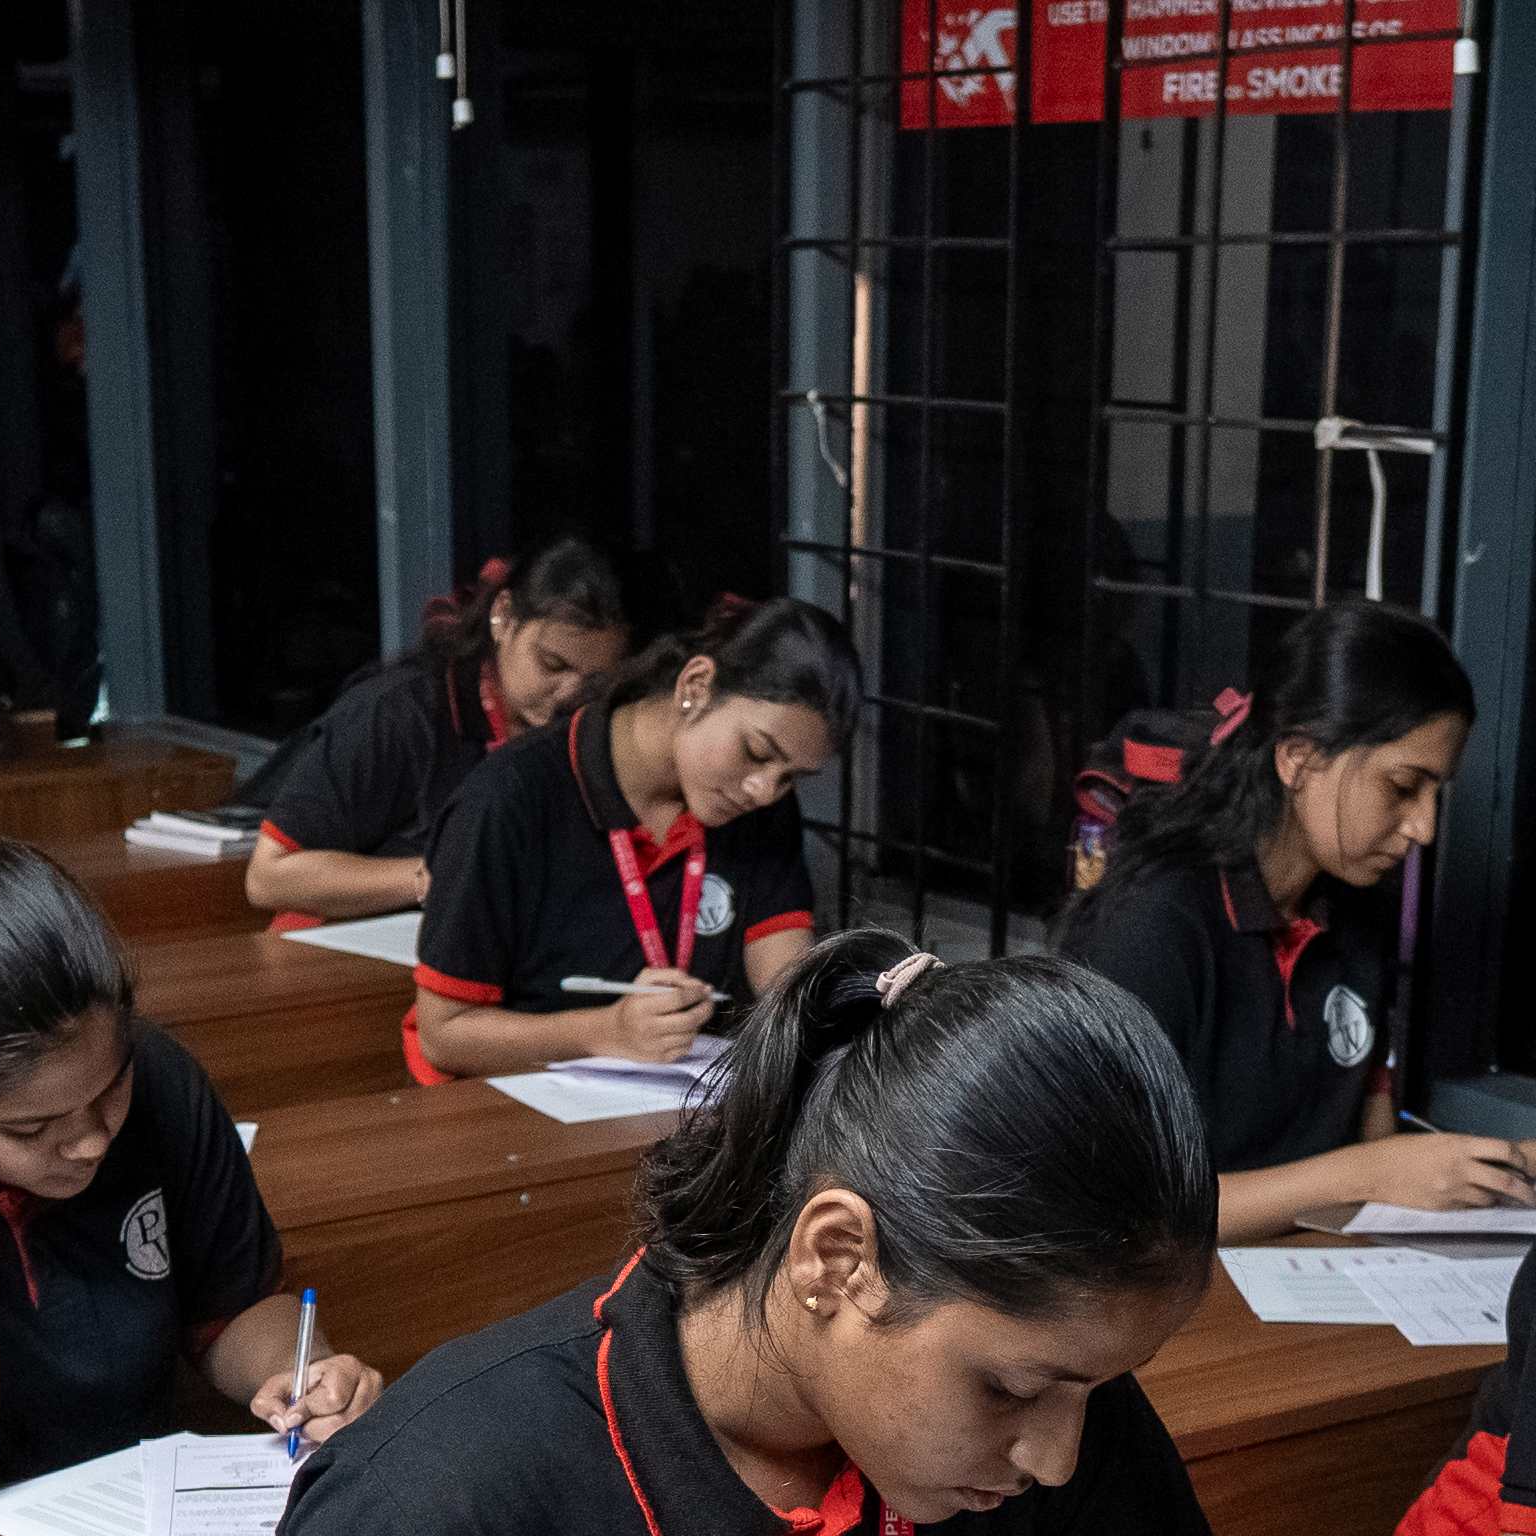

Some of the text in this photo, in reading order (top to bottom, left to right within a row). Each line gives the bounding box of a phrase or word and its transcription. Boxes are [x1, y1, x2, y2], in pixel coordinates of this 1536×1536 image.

[1121, 30, 1214, 60] WINDOW
[1164, 71, 1219, 102] FIRE
[1247, 64, 1343, 99] SMOKE
